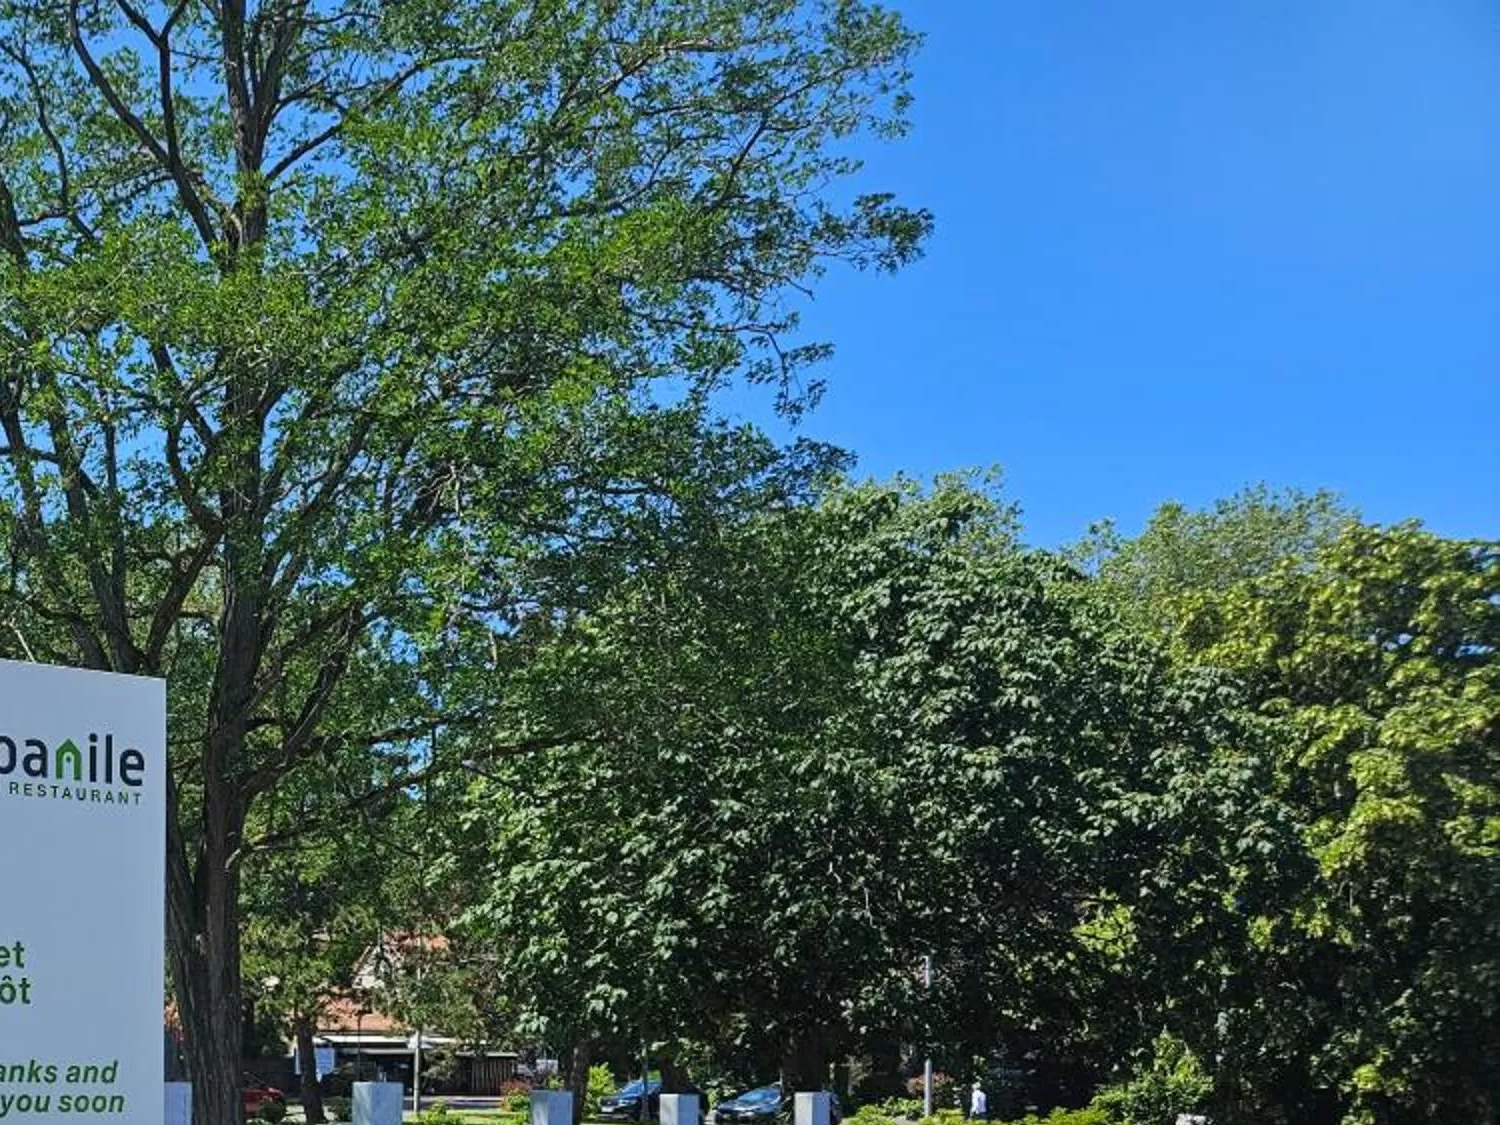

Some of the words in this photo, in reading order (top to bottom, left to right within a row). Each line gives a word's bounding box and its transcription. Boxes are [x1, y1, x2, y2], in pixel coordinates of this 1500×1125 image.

[9, 781, 142, 806] RESTAURANT
[65, 1060, 119, 1085] and
[57, 1094, 125, 1114] soon
